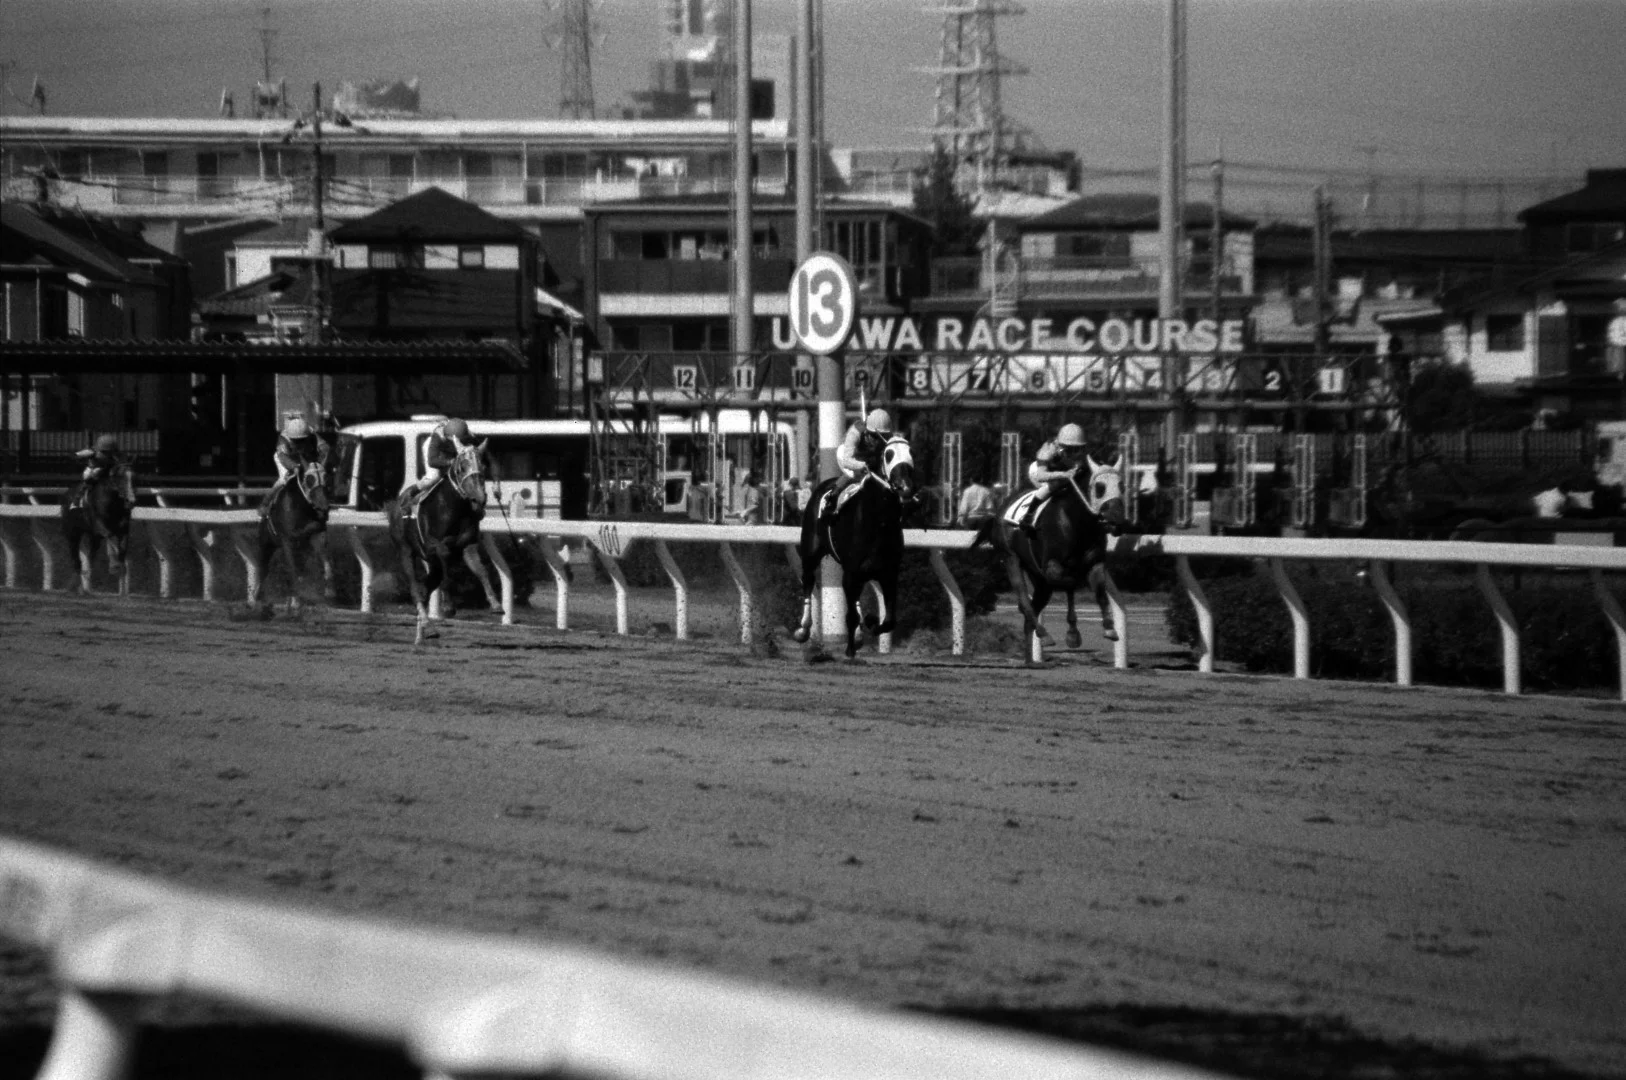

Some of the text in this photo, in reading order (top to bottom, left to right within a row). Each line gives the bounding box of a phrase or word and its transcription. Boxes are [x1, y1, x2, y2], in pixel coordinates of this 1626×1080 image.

[799, 269, 844, 339] 13
[772, 317, 1244, 352] UWA RACE COURSE
[677, 368, 694, 388] 12
[736, 369, 752, 388] 11
[795, 369, 812, 387] 10
[913, 370, 928, 389] 8
[972, 370, 987, 389] 7
[1031, 370, 1045, 389] 6
[1090, 371, 1104, 389] 5
[1265, 371, 1281, 391] 2
